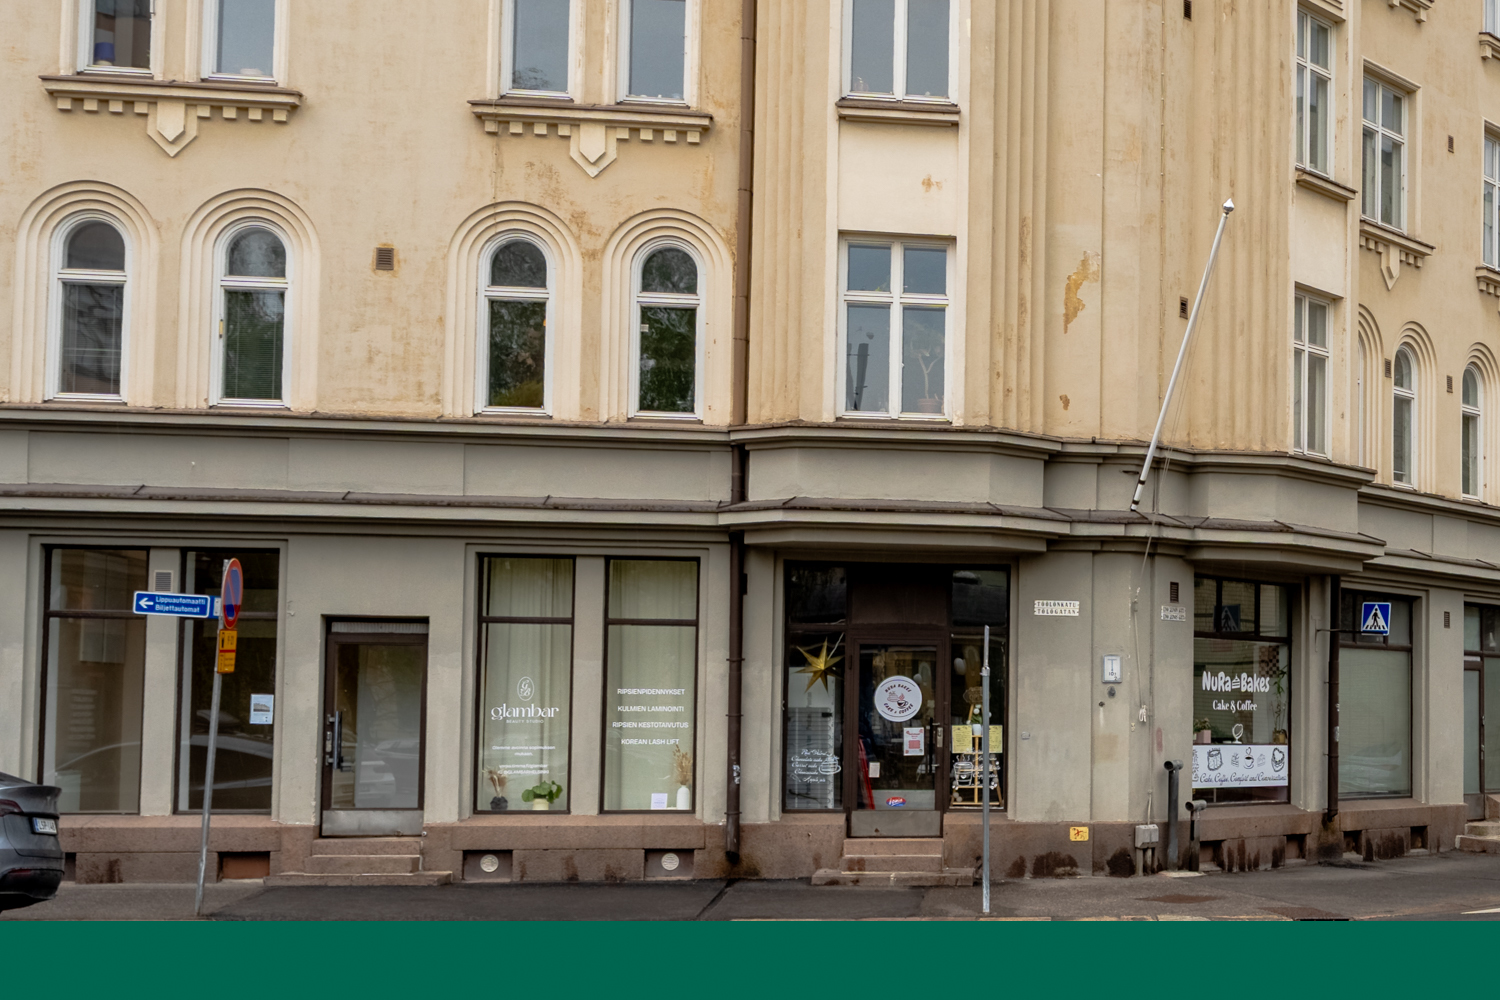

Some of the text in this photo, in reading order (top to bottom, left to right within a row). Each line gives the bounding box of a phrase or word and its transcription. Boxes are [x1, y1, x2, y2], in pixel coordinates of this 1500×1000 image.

[155, 596, 206, 605] Lippuautomaatti
[155, 604, 200, 613] Biljettautomat
[1202, 670, 1270, 693] NuRa Bakes
[491, 703, 559, 720] glambar
[1212, 699, 1258, 713] Cake & Coffee
